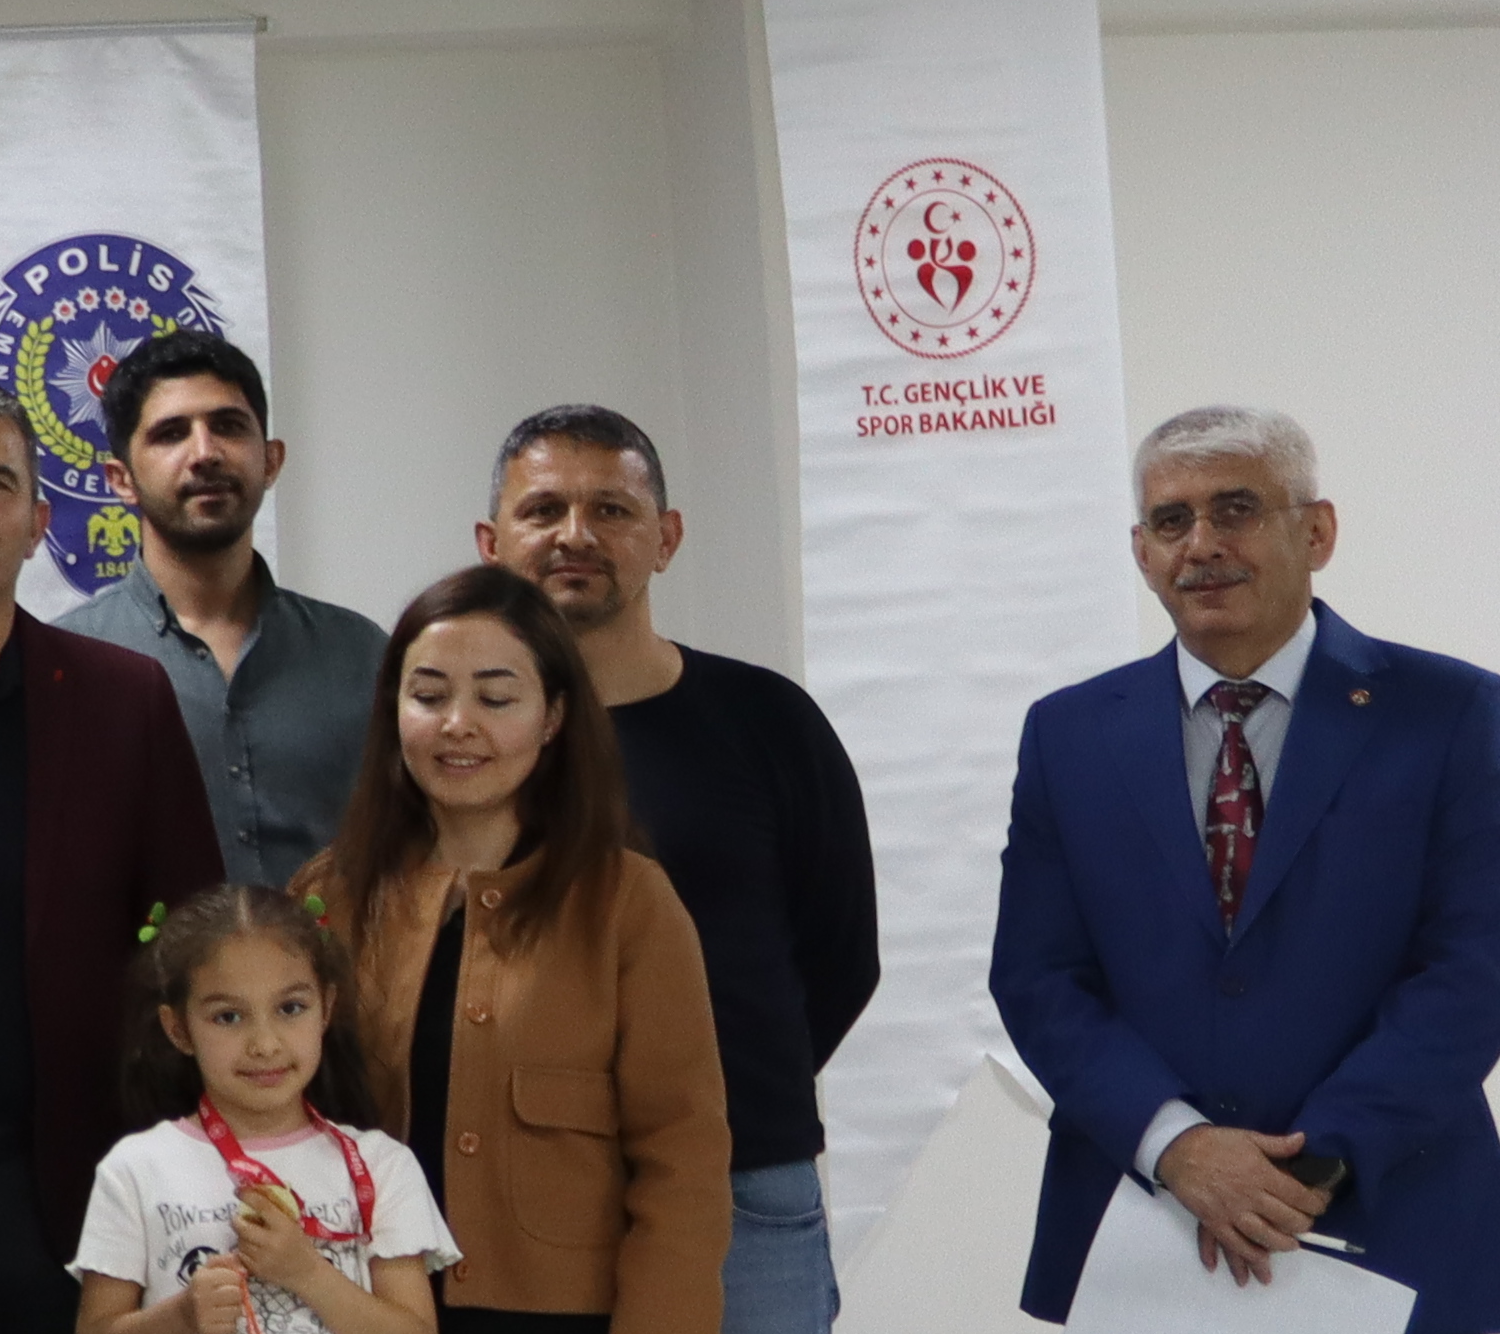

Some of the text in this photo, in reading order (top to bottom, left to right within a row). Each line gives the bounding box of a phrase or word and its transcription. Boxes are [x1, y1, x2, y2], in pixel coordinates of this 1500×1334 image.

[23, 244, 174, 295] POLİS
[861, 374, 1046, 407] T.C. GENÇLİK VE
[857, 400, 1056, 437] SPOR BAKANLIĞI
[156, 1201, 238, 1236] POWERP
